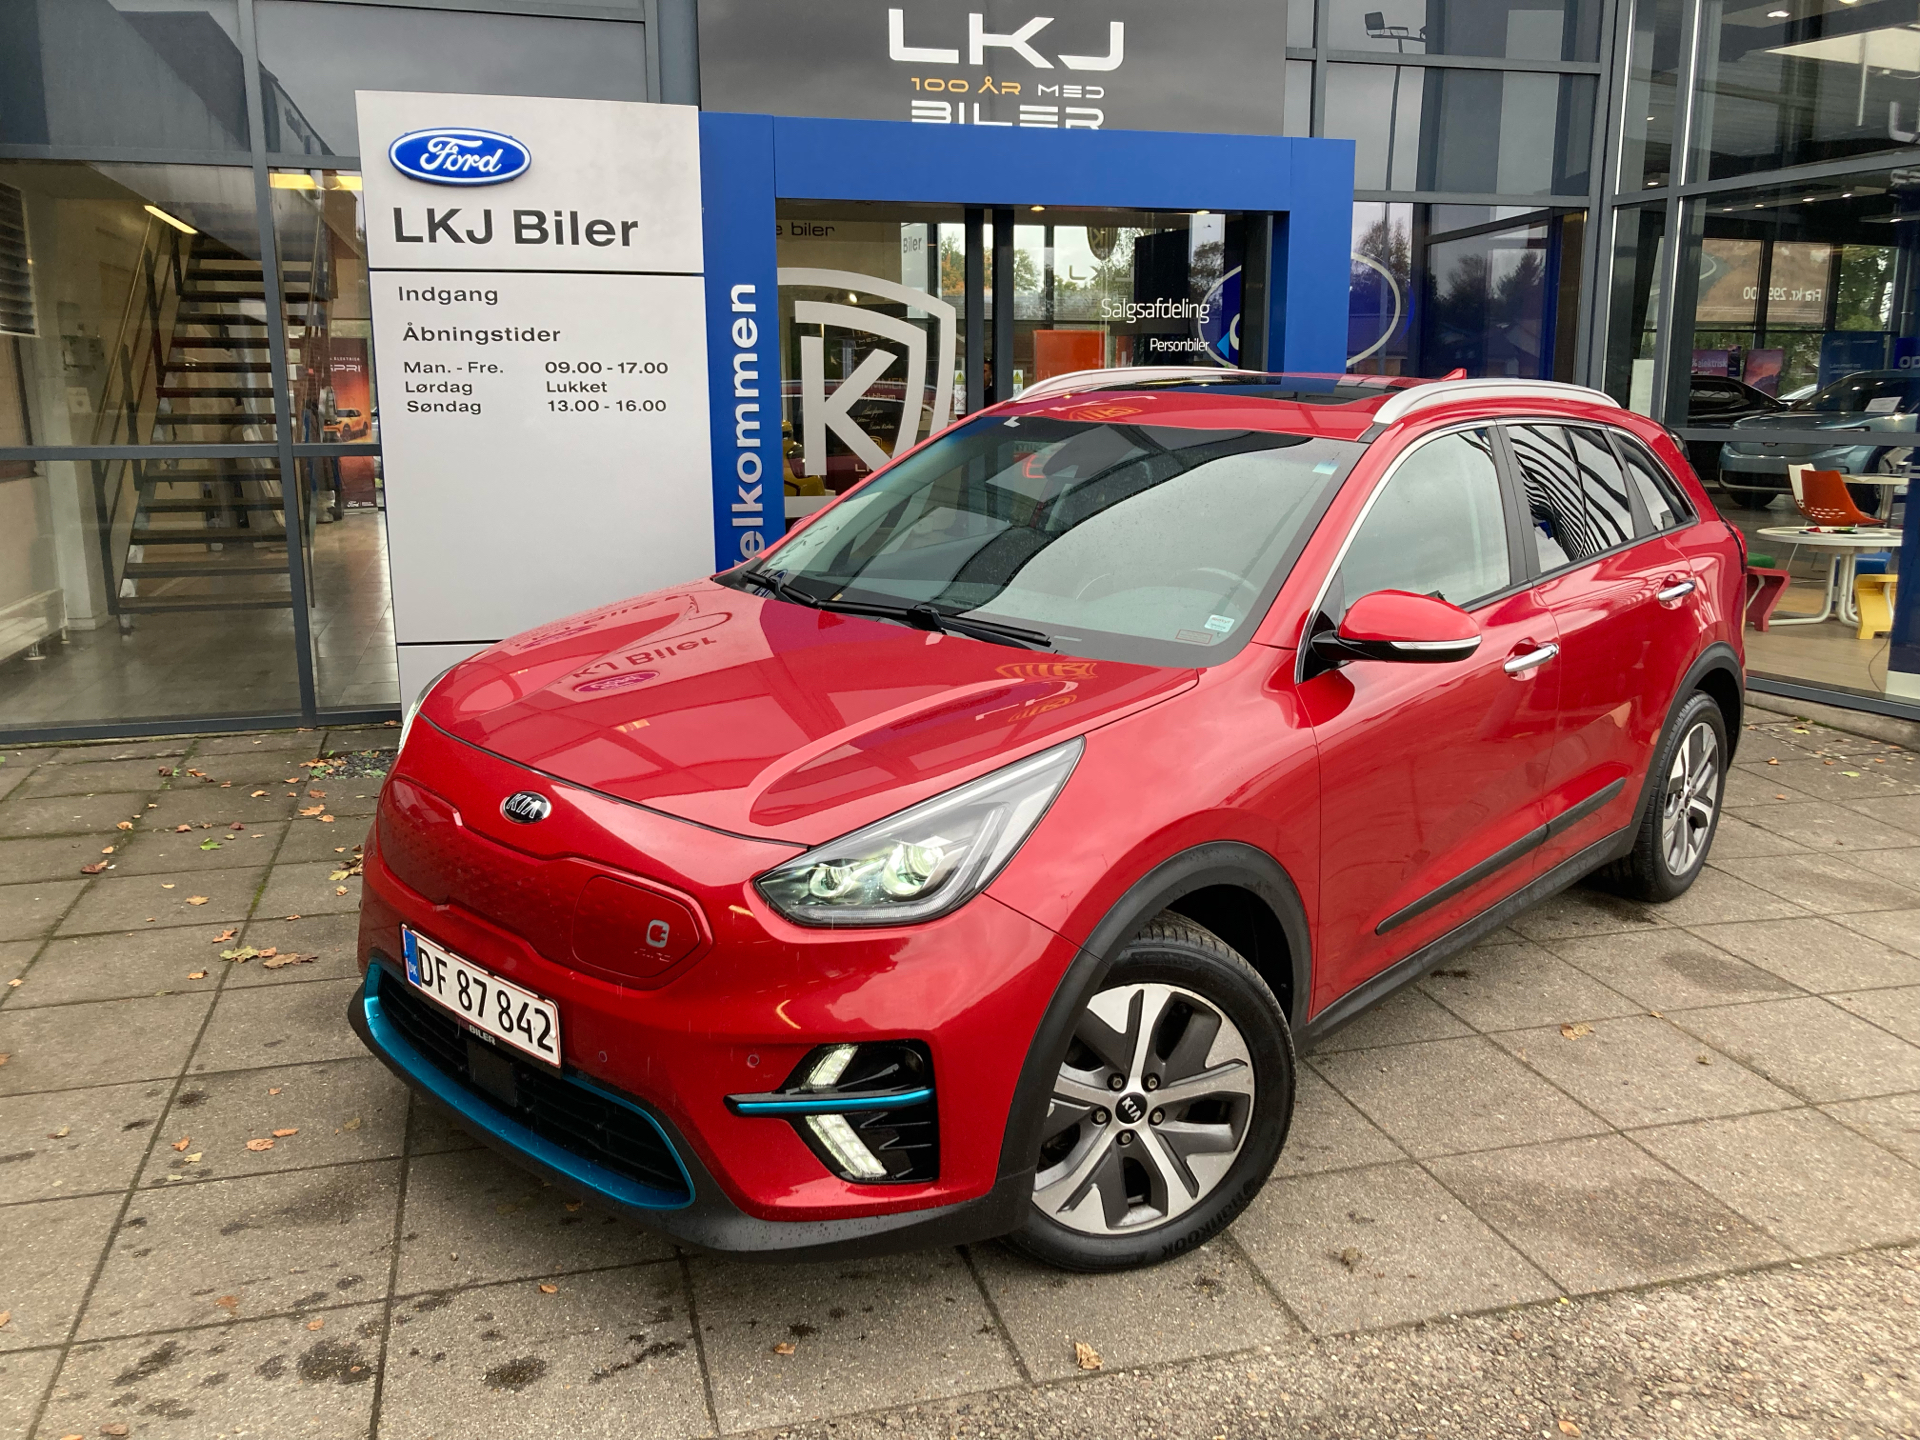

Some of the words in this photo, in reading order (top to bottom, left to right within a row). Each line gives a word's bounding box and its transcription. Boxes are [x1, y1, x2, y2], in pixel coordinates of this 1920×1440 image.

[888, 8, 1125, 72] LKJ
[911, 77, 970, 93] 100
[978, 76, 1022, 96] ÅR
[1038, 83, 1105, 99] MED
[911, 100, 1105, 130] BILER
[419, 136, 504, 174] Ford
[393, 207, 493, 245] LKJ
[513, 209, 639, 247] Biler
[791, 222, 835, 237] biler
[398, 286, 498, 306] Indgang
[1101, 298, 1210, 324] Salgsafdeling
[402, 321, 561, 346] Åbningstider
[1150, 337, 1210, 352] Personbiler
[403, 361, 451, 374] Man.
[468, 361, 504, 374] Fre.
[545, 361, 602, 374] 09.00
[617, 362, 669, 374] 17.00
[405, 380, 473, 396] Lørdag
[546, 380, 608, 393] Lukket
[406, 400, 482, 416] Søndag
[547, 399, 600, 412] 13.00
[615, 399, 667, 412] 16.00
[731, 284, 767, 566] elkommen
[505, 793, 543, 819] KIA
[418, 946, 448, 996] DF
[456, 969, 488, 1018] 87
[496, 989, 554, 1054] 842
[468, 1024, 496, 1046] BILER
[1121, 1096, 1142, 1122] KIA
